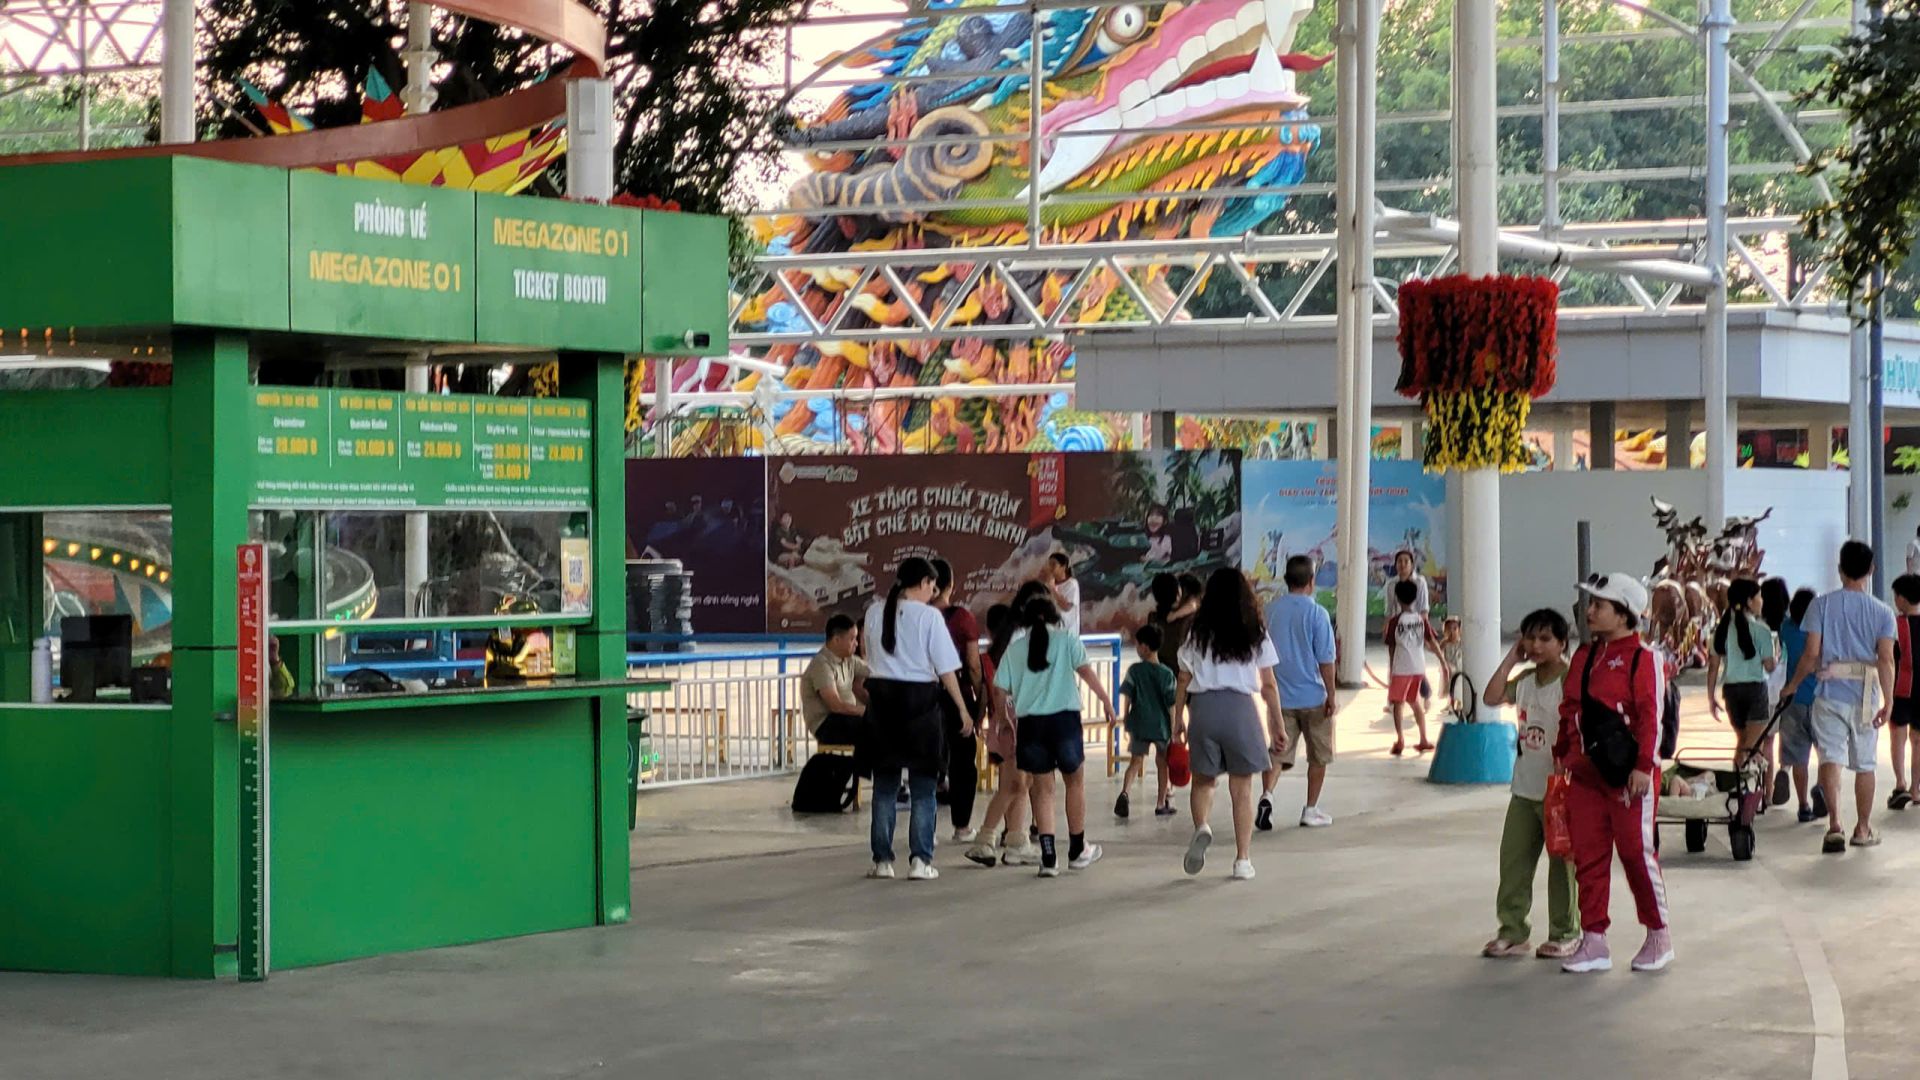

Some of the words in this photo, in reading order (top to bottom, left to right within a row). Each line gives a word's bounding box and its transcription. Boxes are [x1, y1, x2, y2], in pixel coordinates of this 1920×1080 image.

[354, 197, 405, 237] PHÒNG
[409, 201, 427, 240] VÉ
[493, 217, 602, 255] MEGAZONE
[309, 250, 431, 291] MEGAZONE
[513, 268, 559, 301] TICKET
[563, 273, 606, 304] BOOTH
[848, 496, 872, 519] XE
[923, 480, 975, 508] CHIẾN
[935, 509, 984, 535] CHIẾN
